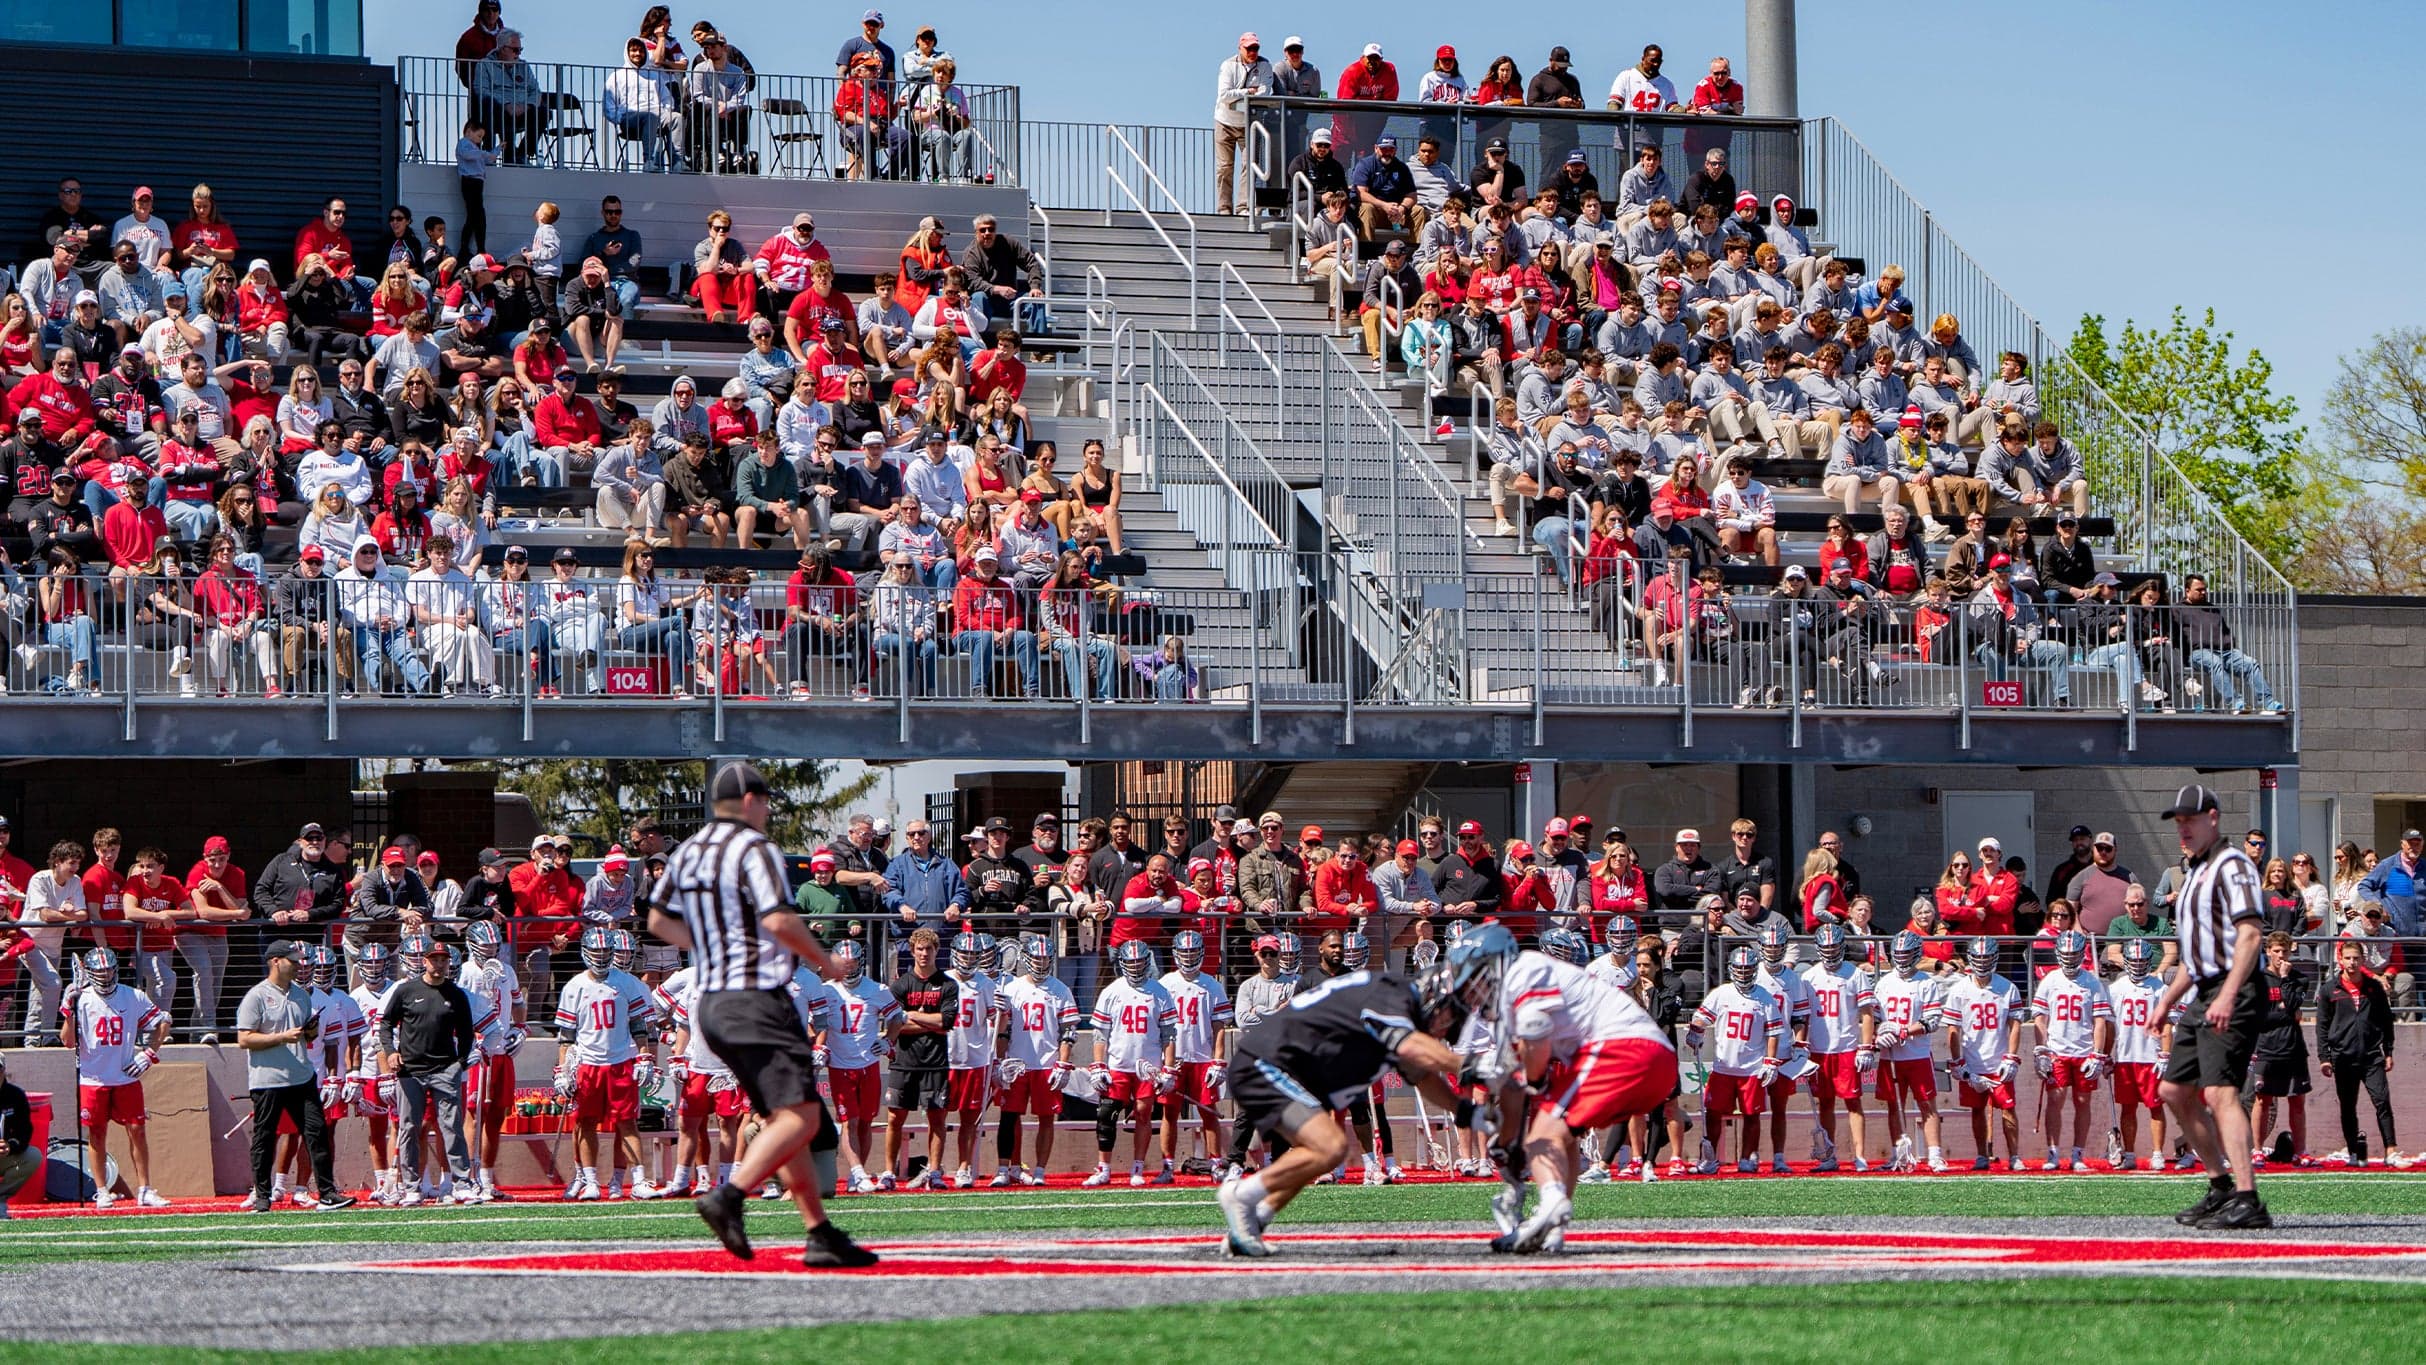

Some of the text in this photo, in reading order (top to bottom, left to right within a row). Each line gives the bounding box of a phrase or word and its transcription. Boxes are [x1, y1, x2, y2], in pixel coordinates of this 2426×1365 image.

[17, 465, 51, 496] 20
[612, 672, 648, 690] 104
[1988, 686, 2018, 702] 105
[591, 999, 616, 1031] 10
[1022, 1002, 1046, 1032] 13
[1177, 996, 1199, 1025] 14
[1815, 990, 1839, 1018] 30
[1887, 997, 1911, 1025] 23
[1970, 1002, 1998, 1031] 38
[2056, 995, 2083, 1021] 26
[2123, 999, 2149, 1026] 33
[95, 1016, 123, 1046] 48
[840, 1004, 864, 1034] 17
[1121, 1005, 1149, 1034] 46
[1726, 1011, 1755, 1041] 50
